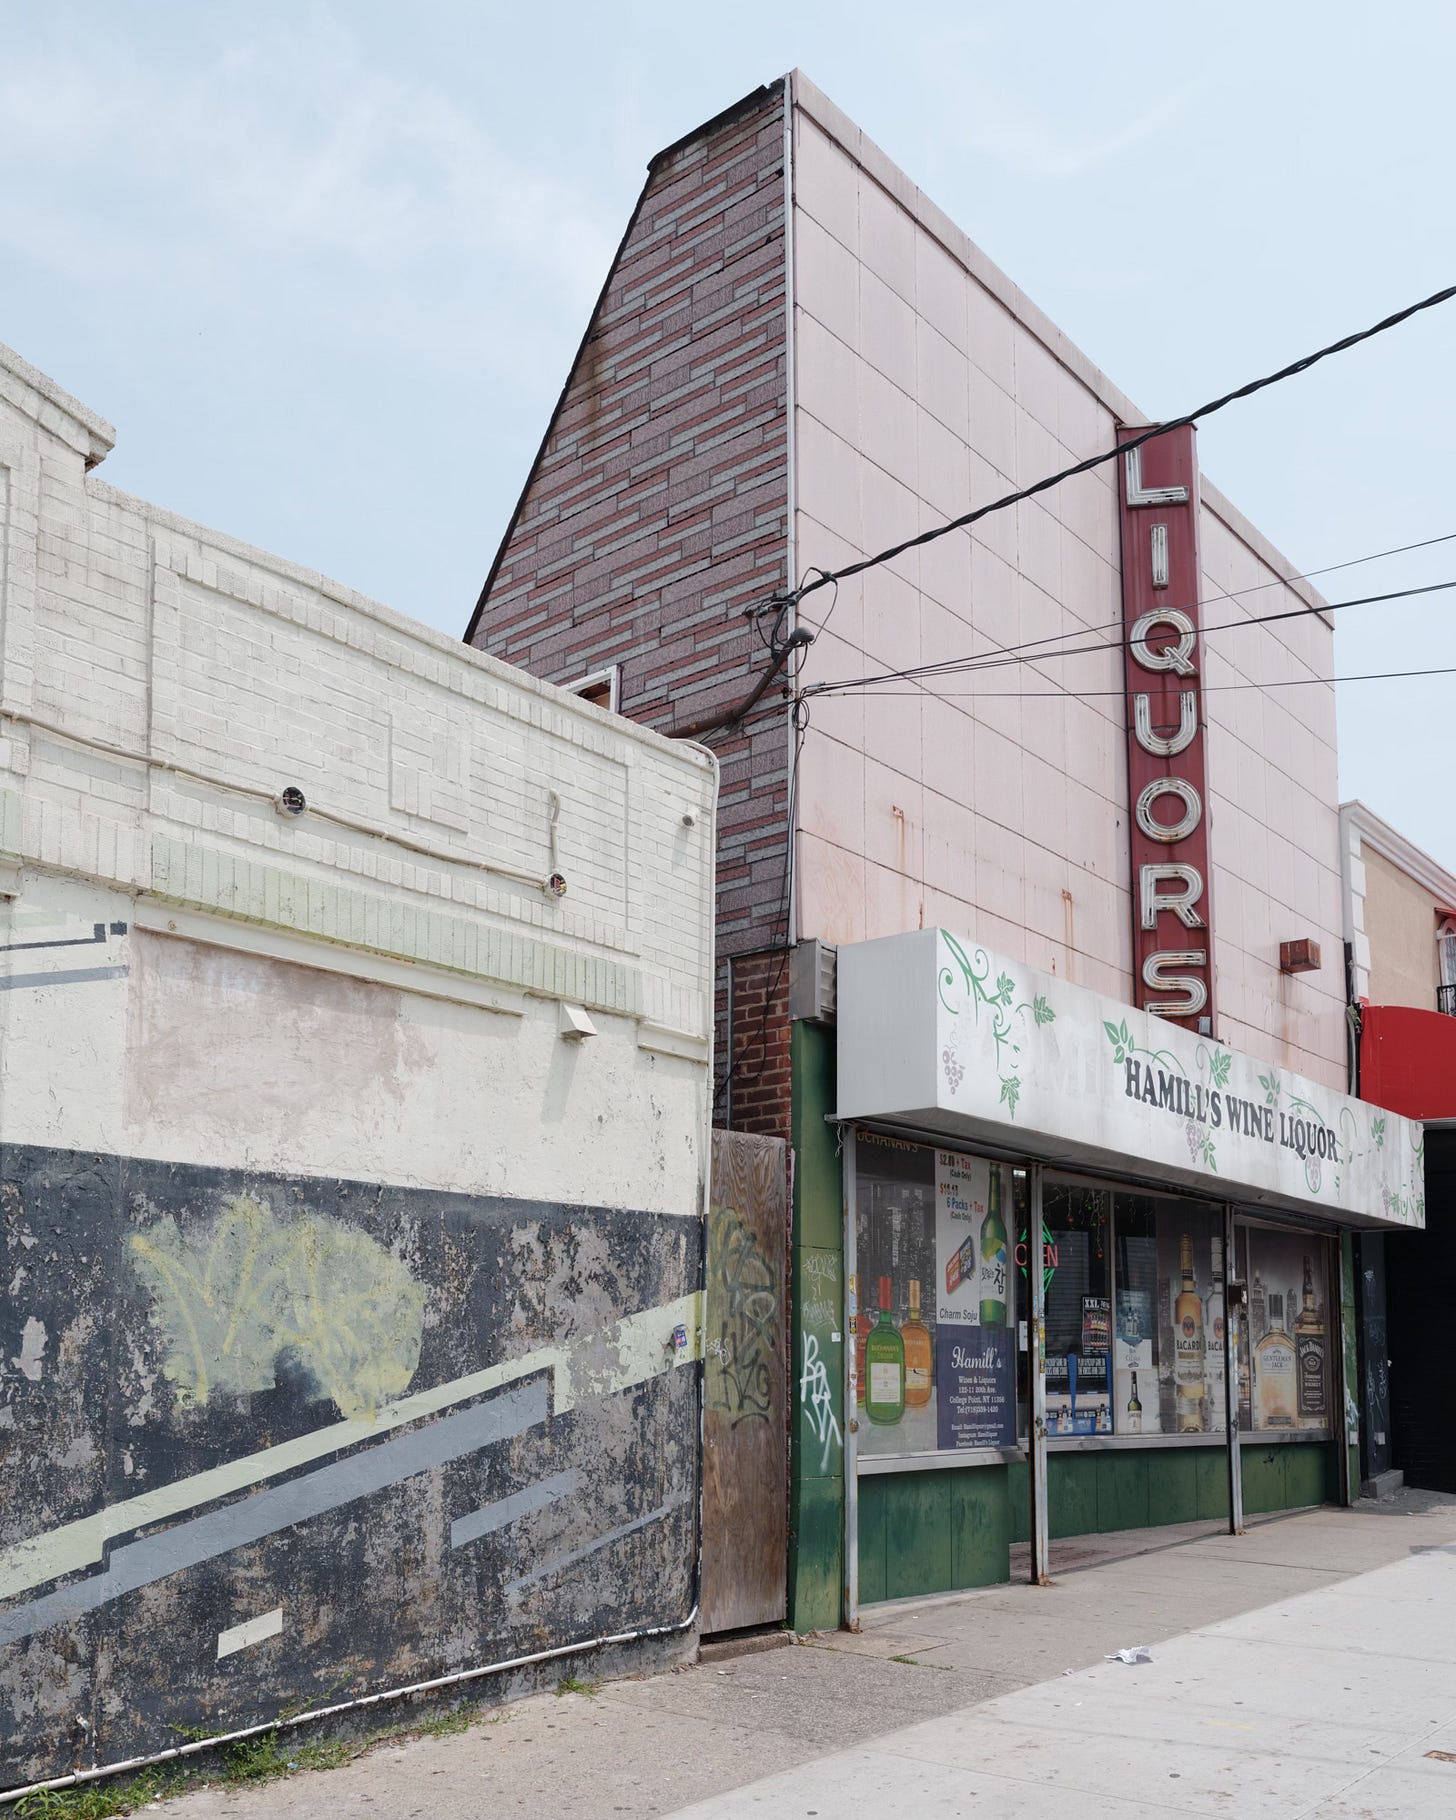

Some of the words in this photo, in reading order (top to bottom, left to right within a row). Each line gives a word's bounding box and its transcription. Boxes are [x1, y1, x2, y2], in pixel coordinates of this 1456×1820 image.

[1125, 446, 1207, 1017] LIQUORS
[1124, 1056, 1222, 1128] HAMILL'S
[1225, 1094, 1275, 1143] WINE
[1279, 1111, 1338, 1162] LIQUOR
[857, 1132, 918, 1152] UCHANAN'S
[961, 1158, 971, 1170] Tax
[952, 1197, 968, 1211] Packs
[974, 1201, 984, 1213] Tax
[1014, 1243, 1059, 1267] OEN
[993, 1263, 1006, 1295] 참
[1085, 1299, 1099, 1308] XXL
[940, 1308, 961, 1319] Charm
[963, 1309, 978, 1322] Soju
[1207, 1341, 1224, 1351] BACA
[951, 1346, 1002, 1369] Hamill's
[983, 1395, 991, 1403] NY
